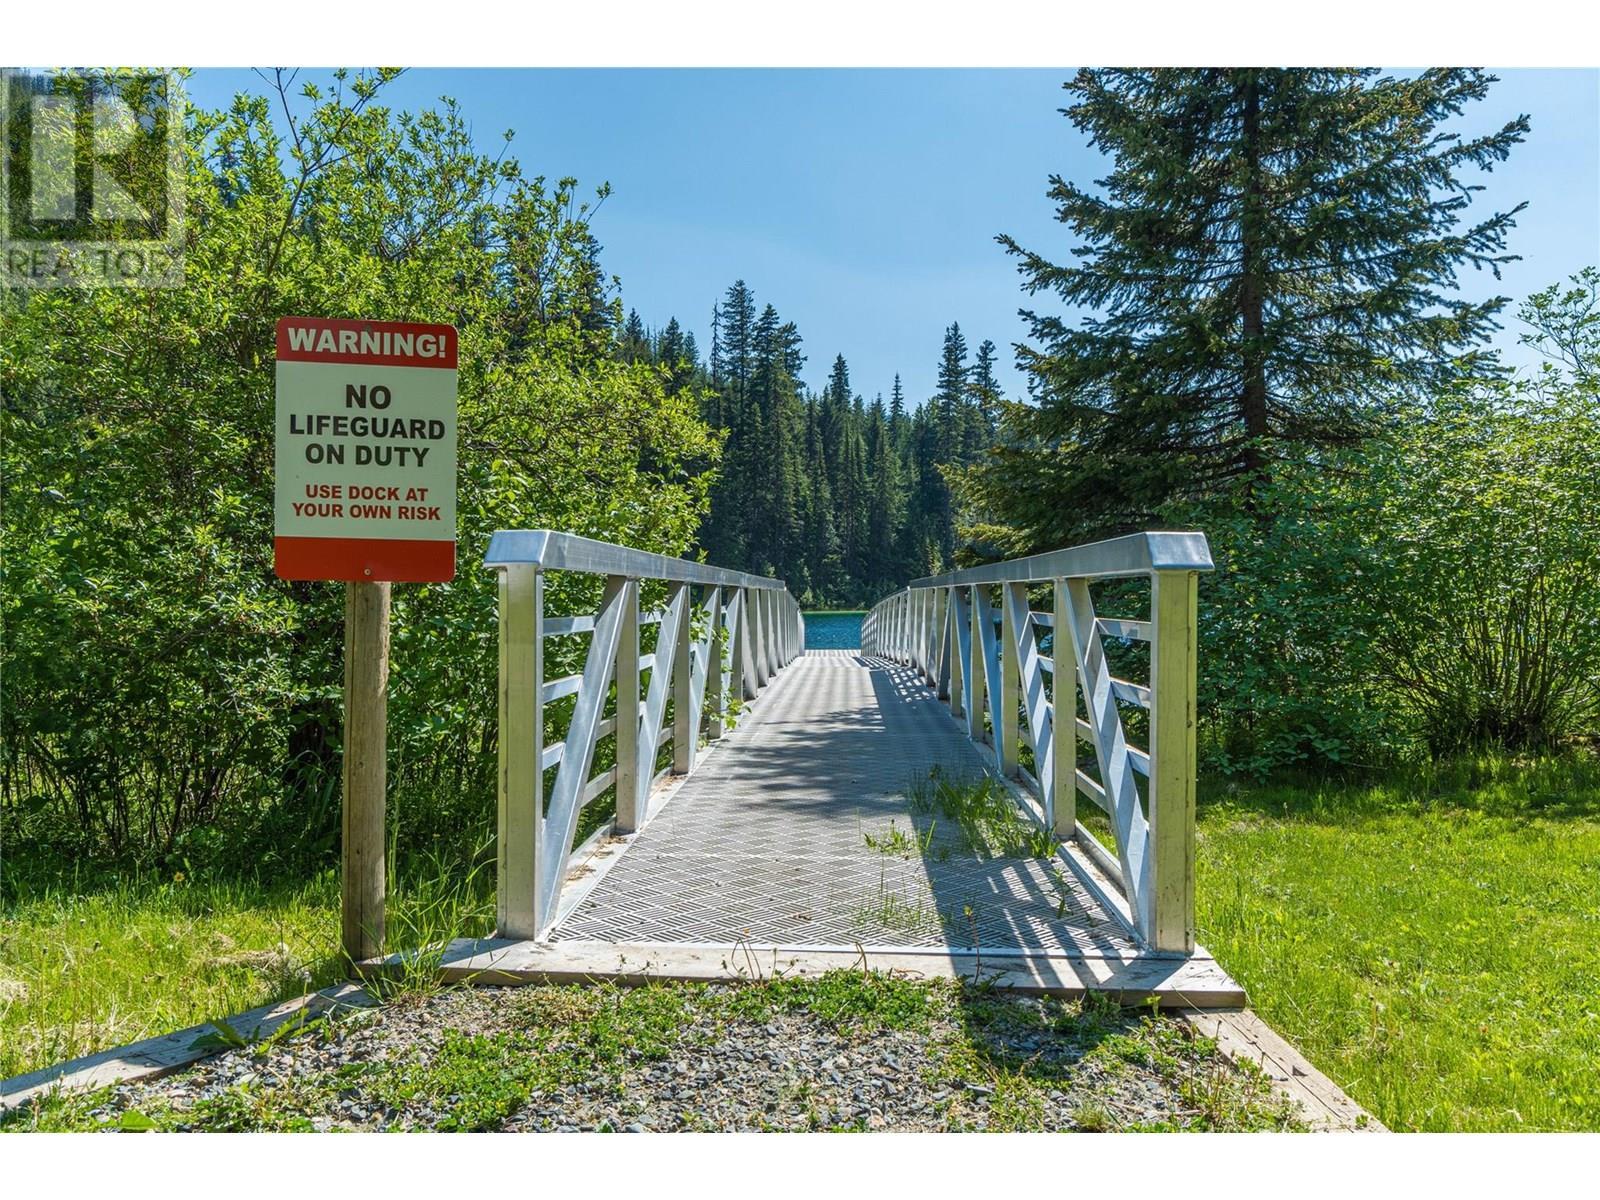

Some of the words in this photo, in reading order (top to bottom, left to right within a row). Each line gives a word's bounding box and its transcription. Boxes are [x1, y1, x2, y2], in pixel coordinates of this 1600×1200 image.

[288, 327, 446, 358] WARNING!
[345, 384, 391, 410] NO
[289, 414, 446, 440] LIFEGUARD
[305, 443, 345, 465] ON
[355, 445, 430, 467] DUTY
[305, 484, 342, 499] USE
[348, 486, 400, 501] DOCK
[405, 487, 429, 502] AT
[292, 502, 344, 518] YOUR
[350, 504, 392, 519] OWN
[397, 506, 441, 521] RISK
